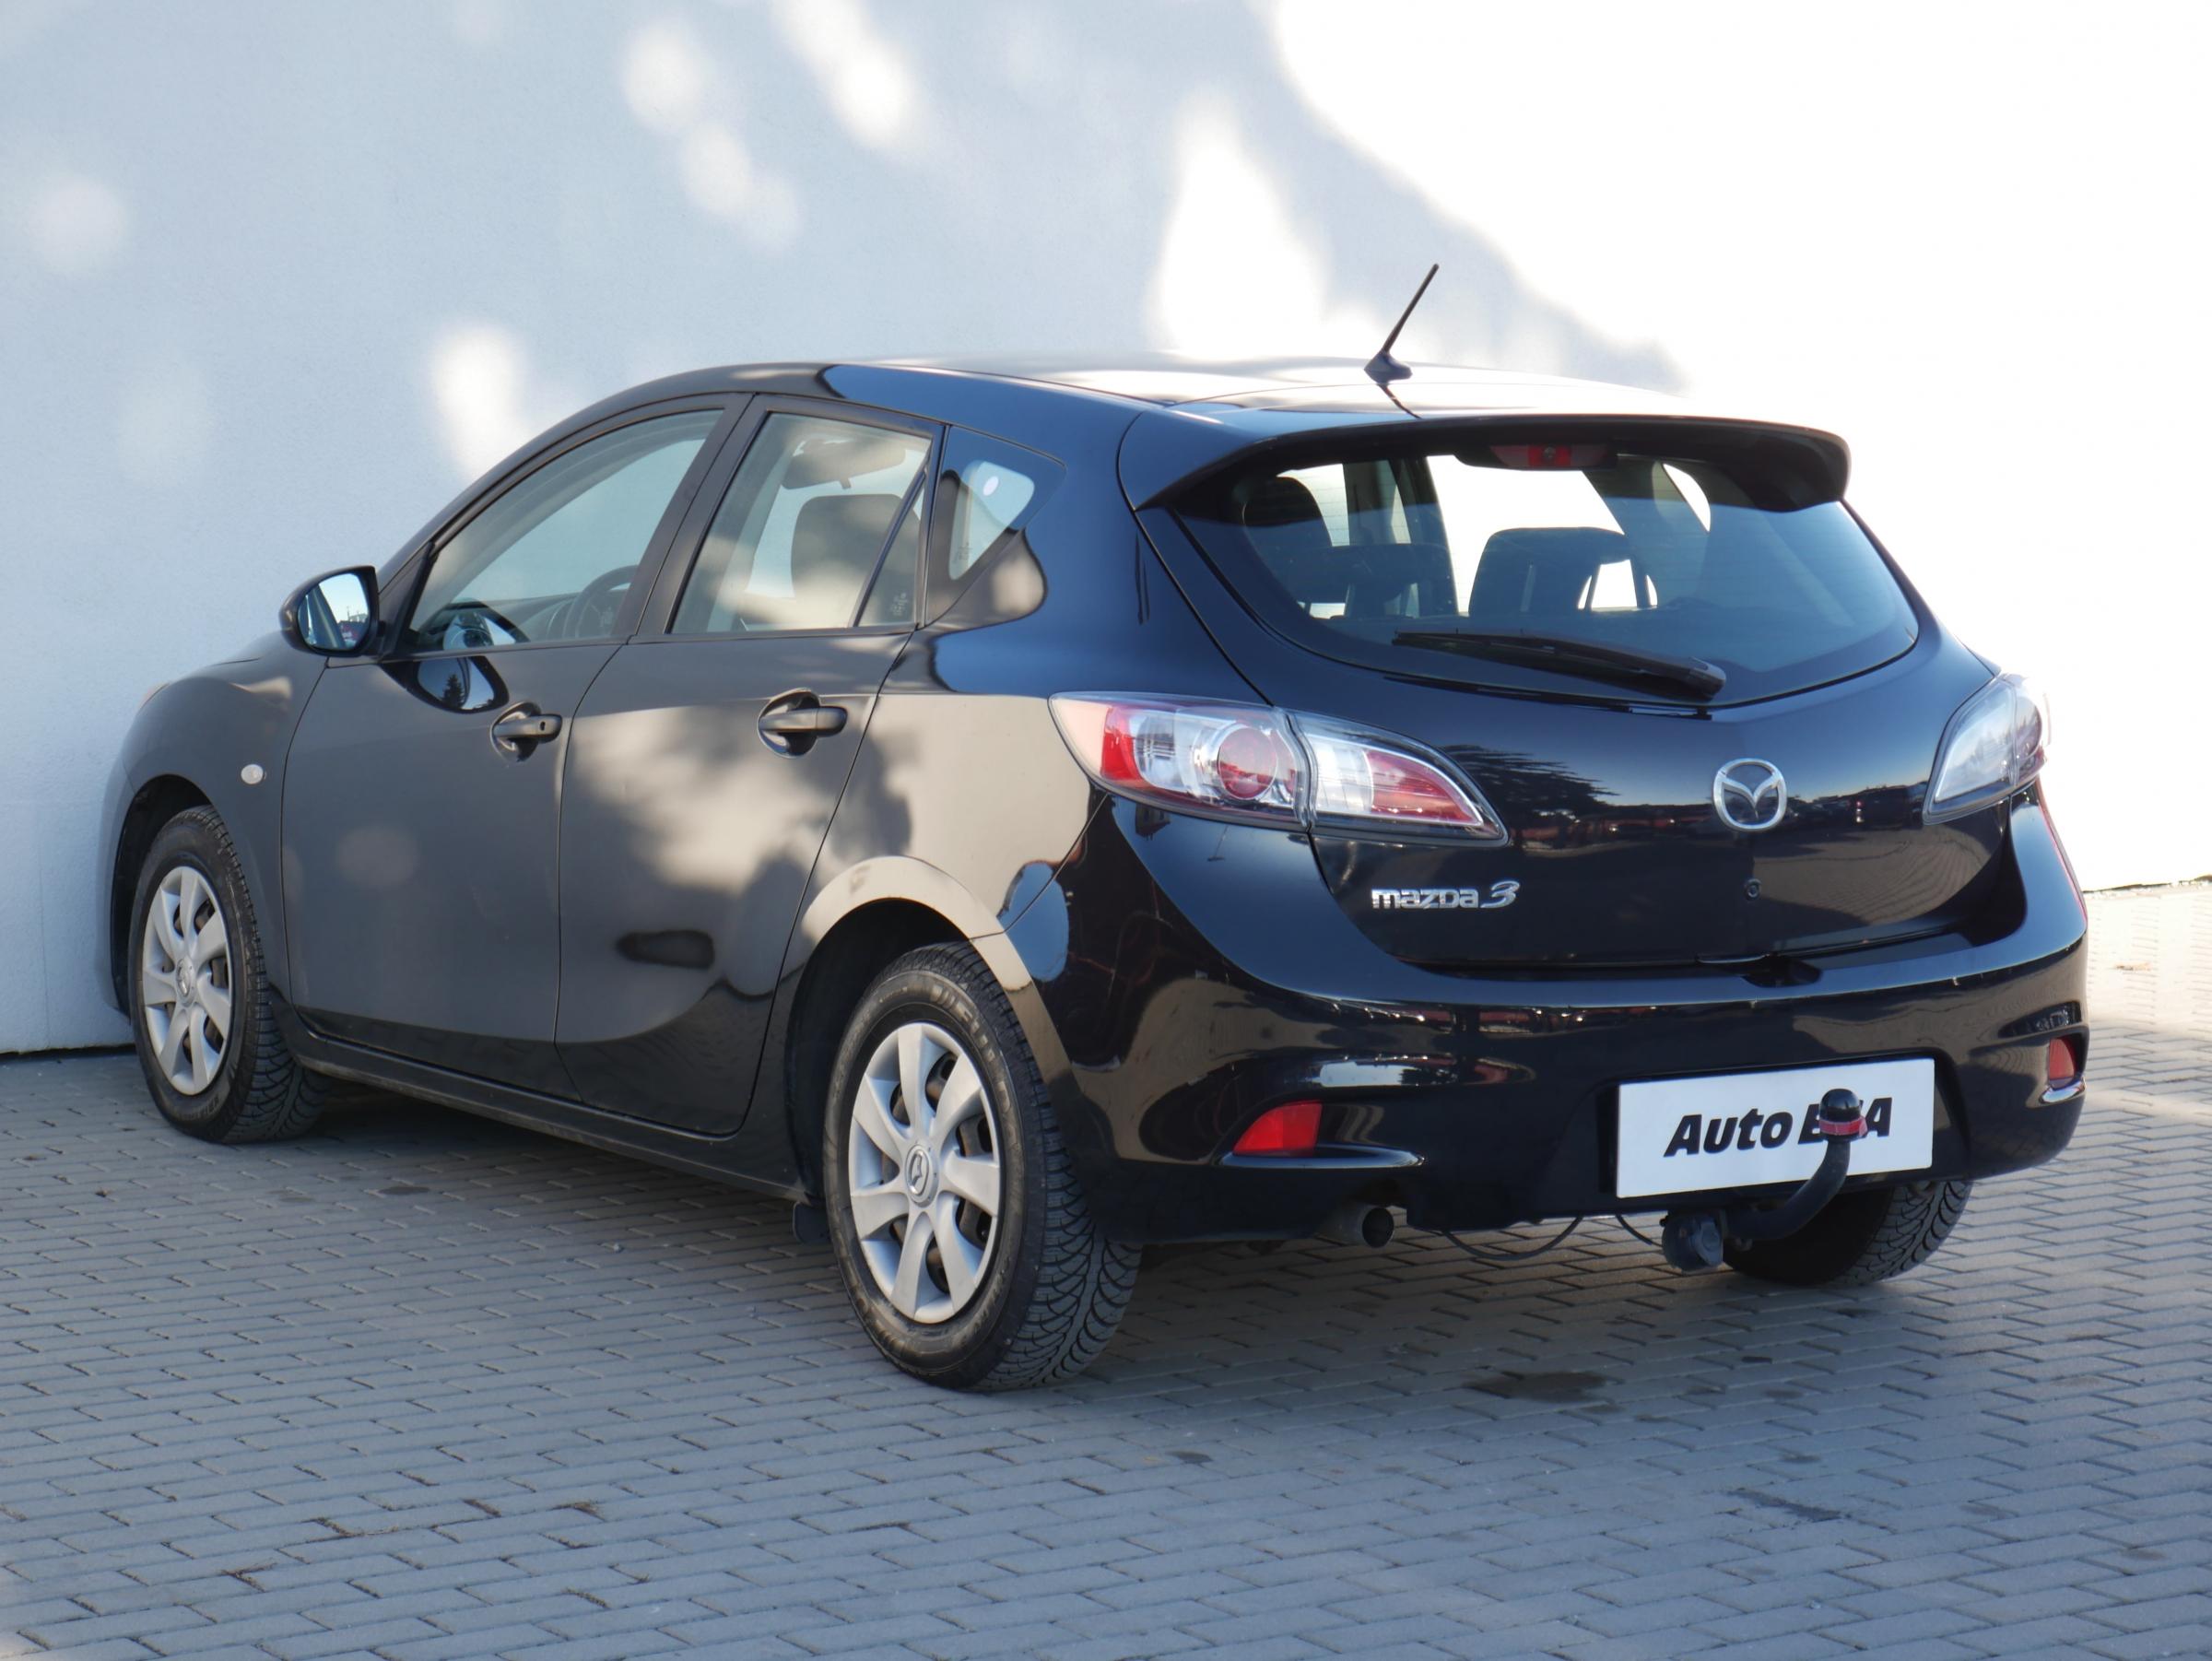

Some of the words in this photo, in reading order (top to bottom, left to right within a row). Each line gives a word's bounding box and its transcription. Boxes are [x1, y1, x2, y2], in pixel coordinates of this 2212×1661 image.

[1480, 879, 1521, 910] 3
[1663, 1107, 1794, 1158] Auto
[1797, 1097, 1893, 1145] EA
